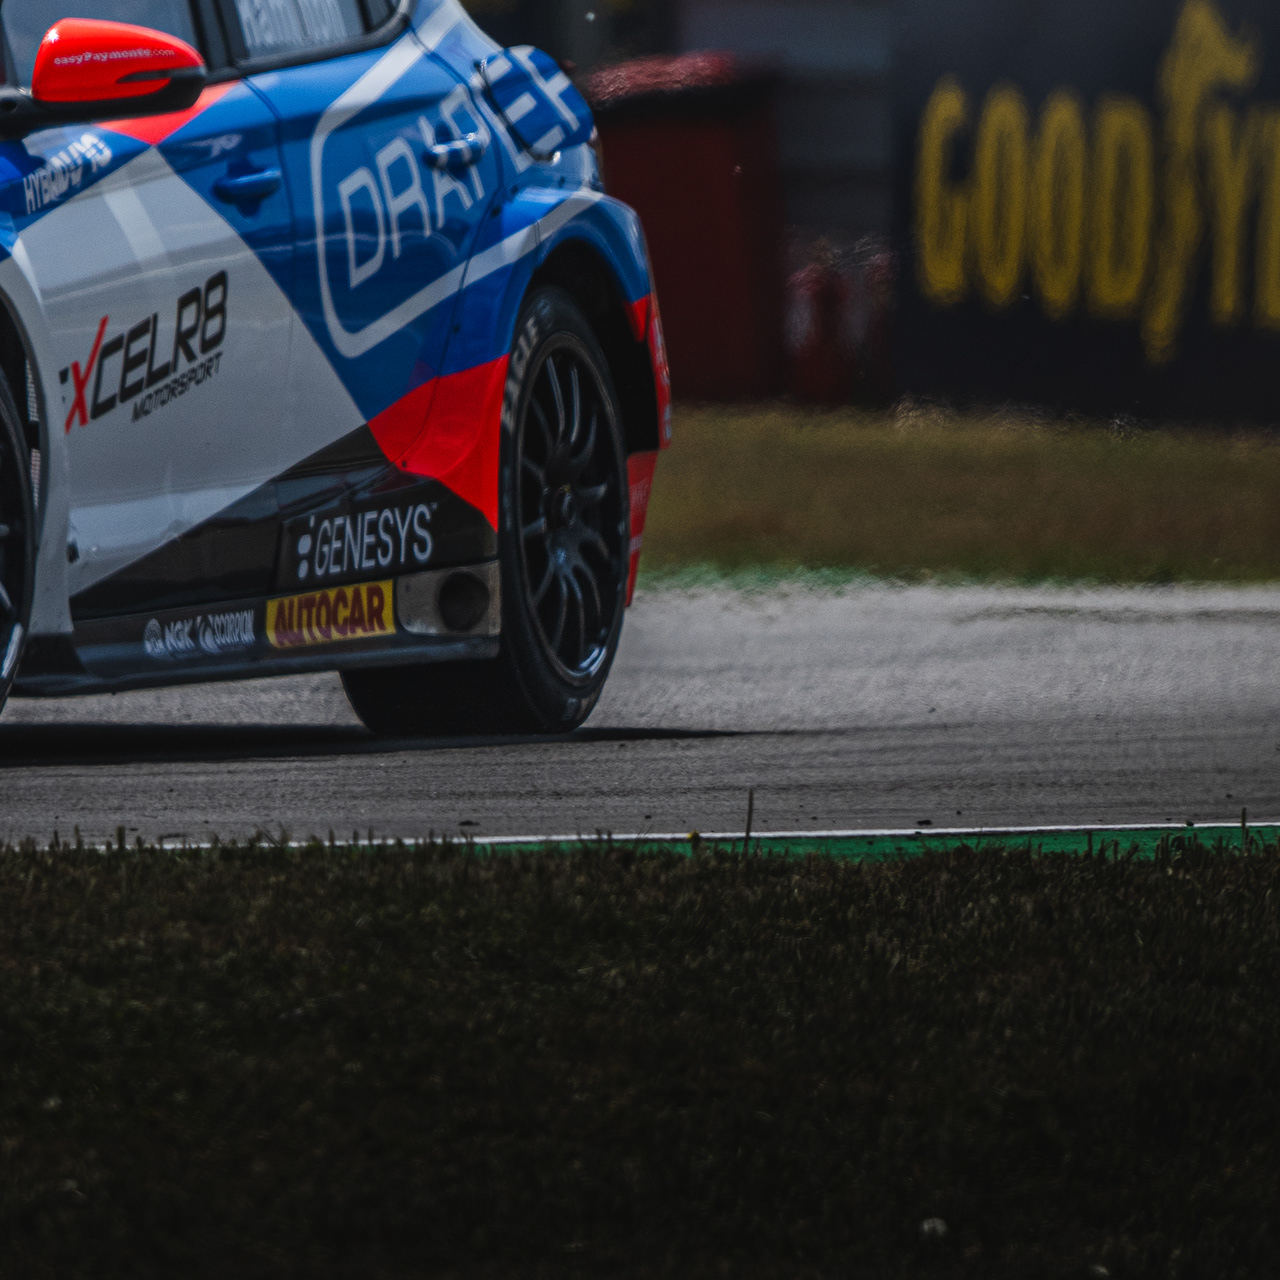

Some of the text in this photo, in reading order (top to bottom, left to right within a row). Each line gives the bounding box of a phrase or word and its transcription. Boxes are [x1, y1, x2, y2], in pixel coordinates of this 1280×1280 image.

[131, 350, 224, 424] MOTORSPORT
[314, 502, 433, 577] GENESYS
[274, 584, 387, 647] AUTOCAR
